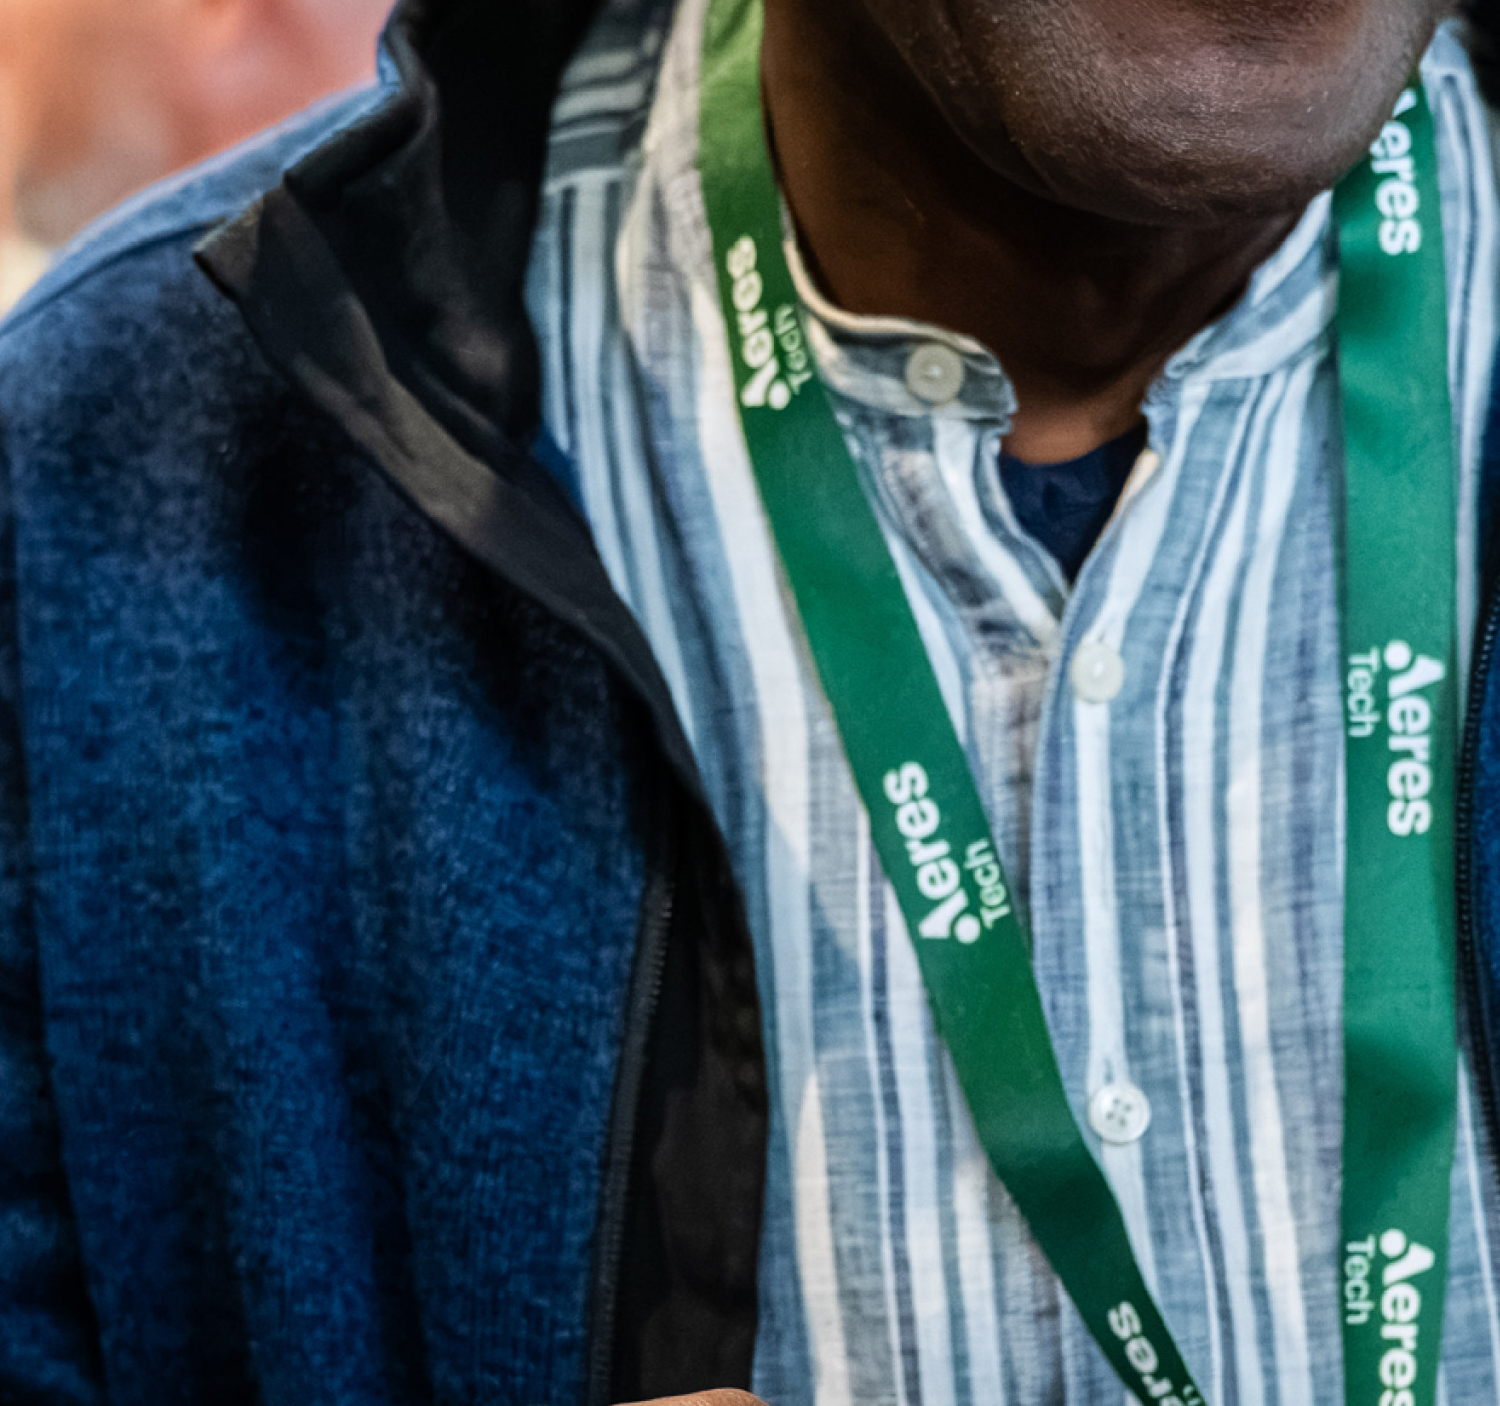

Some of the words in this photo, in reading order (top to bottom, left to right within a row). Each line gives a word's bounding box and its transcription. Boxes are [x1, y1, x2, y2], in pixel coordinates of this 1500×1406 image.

[1369, 88, 1422, 256] eres
[726, 234, 792, 411] Aeres
[1347, 646, 1381, 738] Tech
[1387, 639, 1445, 837] Aeres
[882, 760, 982, 945] Aeres
[964, 837, 1012, 930] Tech
[1344, 1234, 1376, 1325] Tech
[1106, 1301, 1186, 1406] res
